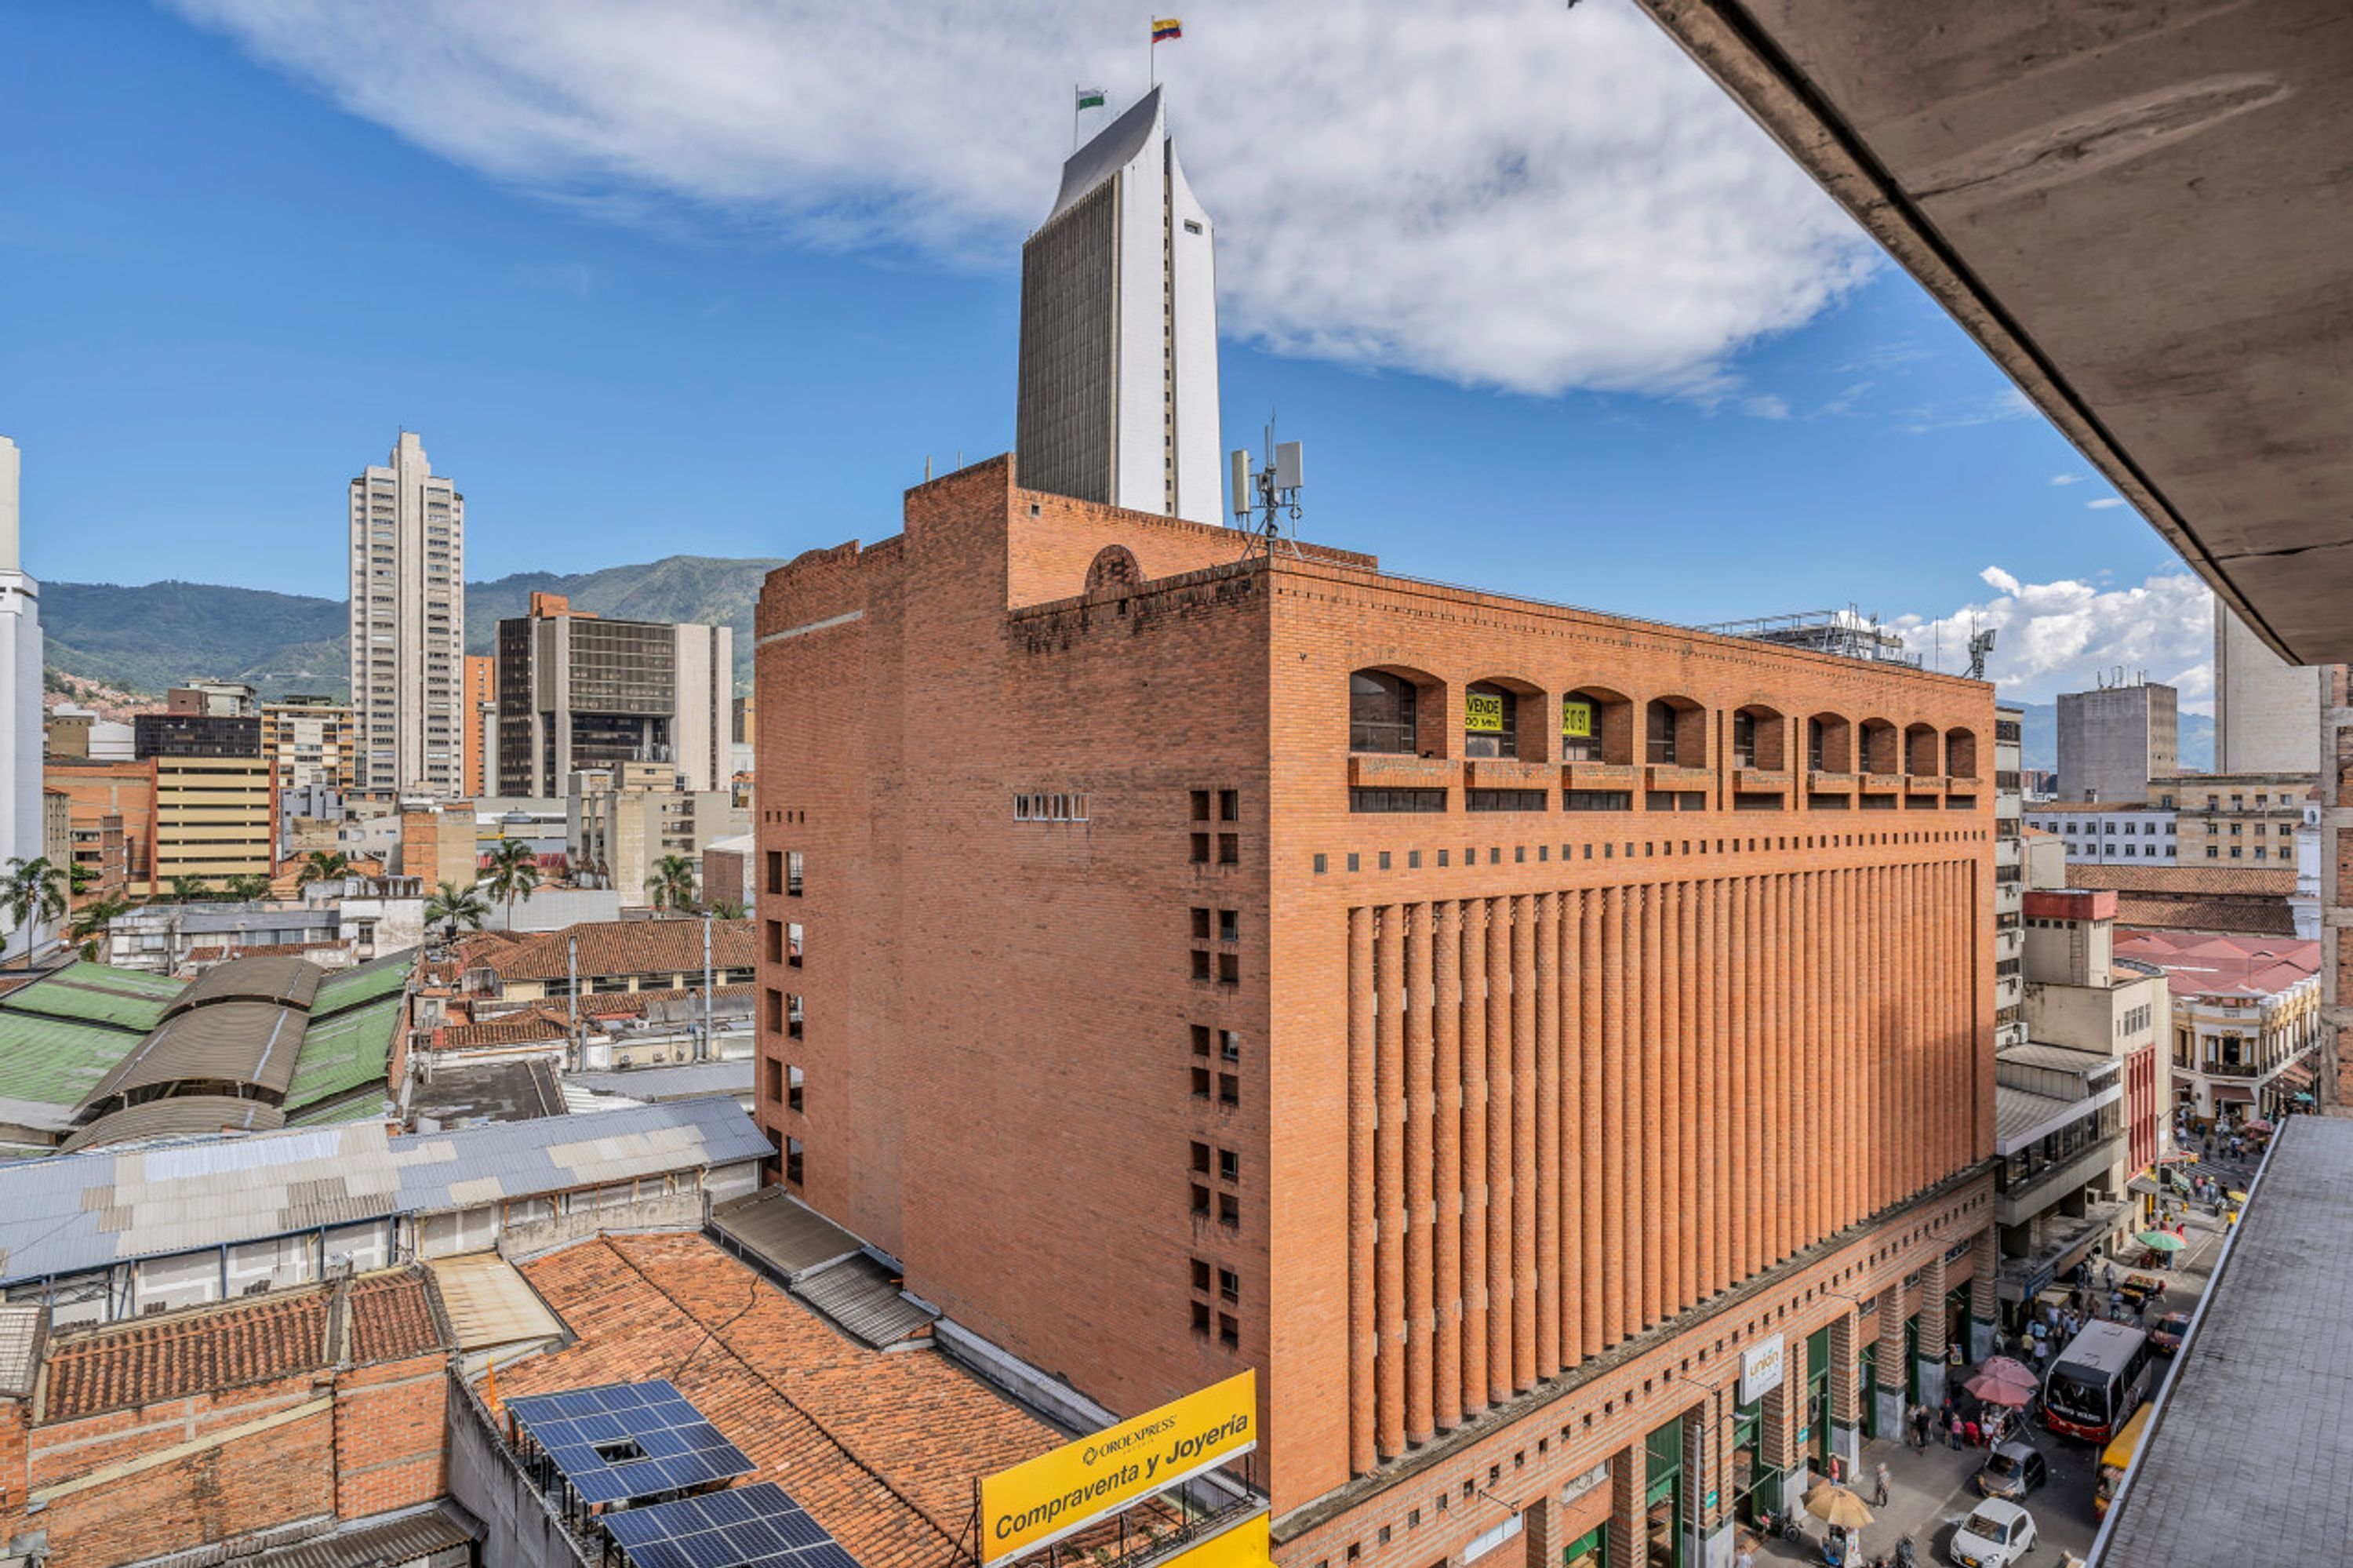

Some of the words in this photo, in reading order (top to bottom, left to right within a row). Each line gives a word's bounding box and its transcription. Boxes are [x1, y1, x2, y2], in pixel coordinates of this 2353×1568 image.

[1466, 698, 1499, 714] VENDE
[1100, 1417, 1176, 1457] OROEXPRESS
[995, 1464, 1139, 1540] Compraventa
[1146, 1453, 1160, 1479] y
[1166, 1413, 1248, 1464] Joyería
